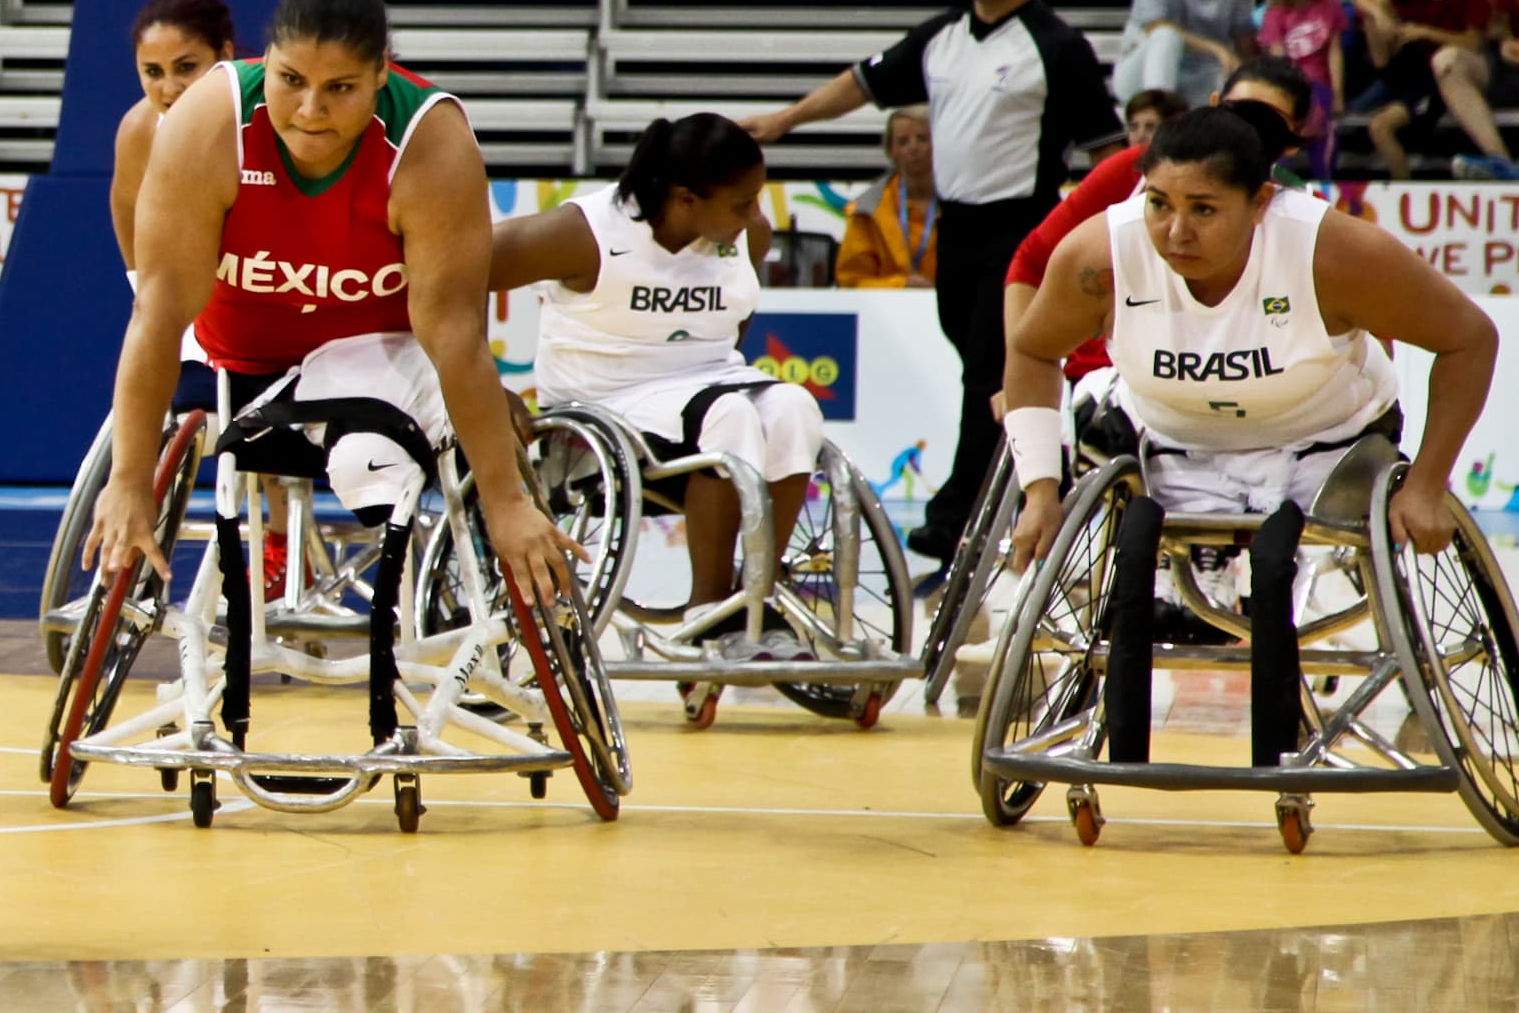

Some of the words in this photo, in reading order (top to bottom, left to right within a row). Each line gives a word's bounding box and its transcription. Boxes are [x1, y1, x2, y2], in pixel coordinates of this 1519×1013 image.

[216, 250, 409, 302] MÉXICO
[629, 285, 728, 313] BRASIL
[1153, 346, 1285, 382] BRASIL
